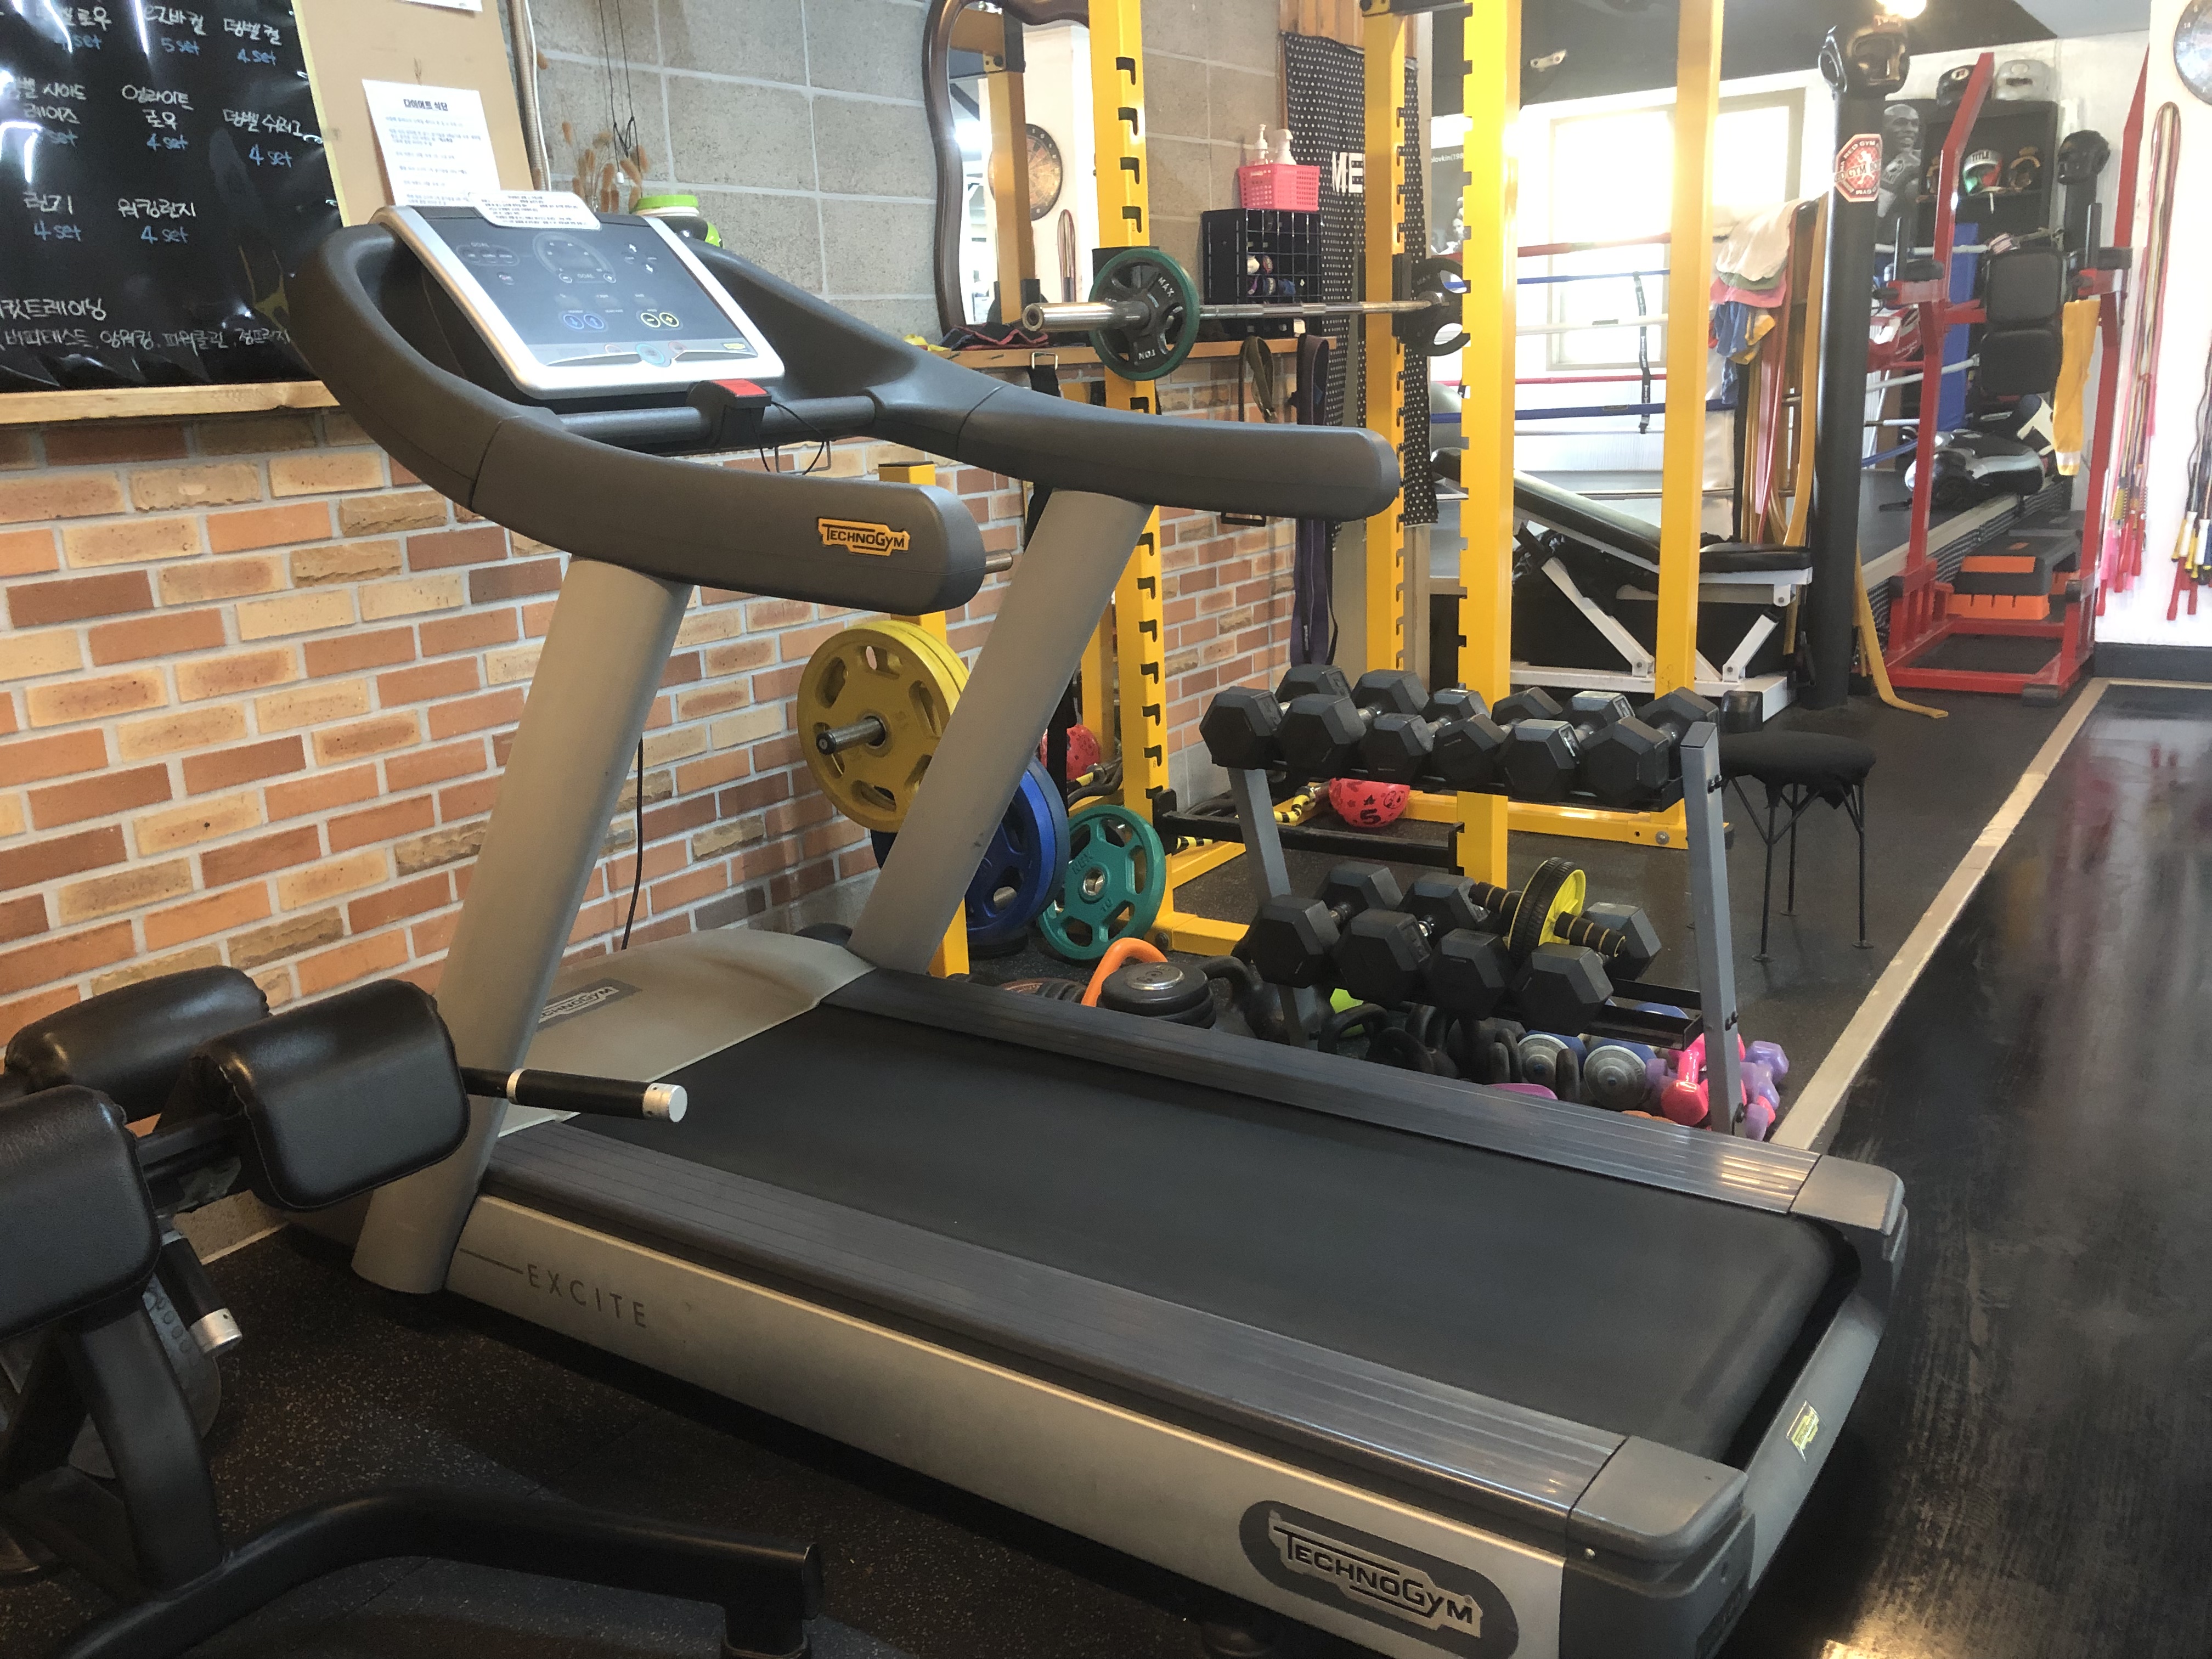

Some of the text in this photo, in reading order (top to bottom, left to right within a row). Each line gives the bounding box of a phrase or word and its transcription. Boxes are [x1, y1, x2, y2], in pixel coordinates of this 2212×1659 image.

[161, 37, 200, 57] 5 set
[237, 48, 276, 66] 4 set
[42, 82, 87, 100] 사이드
[404, 99, 448, 111] 다이어트 식단
[142, 109, 178, 131] 로우
[146, 133, 189, 151] 4 set
[249, 144, 292, 168] 4 set
[1972, 151, 1989, 161] TITLE
[34, 220, 82, 242] 4 set
[141, 225, 189, 244] 4 set
[1158, 277, 1174, 297] MAX
[0, 298, 107, 321] 킷트레이닝
[822, 523, 906, 551] TECHNOGYM
[541, 986, 613, 1017] CHNOGYM
[527, 1263, 646, 1328] EXCITE
[1273, 1526, 1472, 1624] TECHNOGYM
